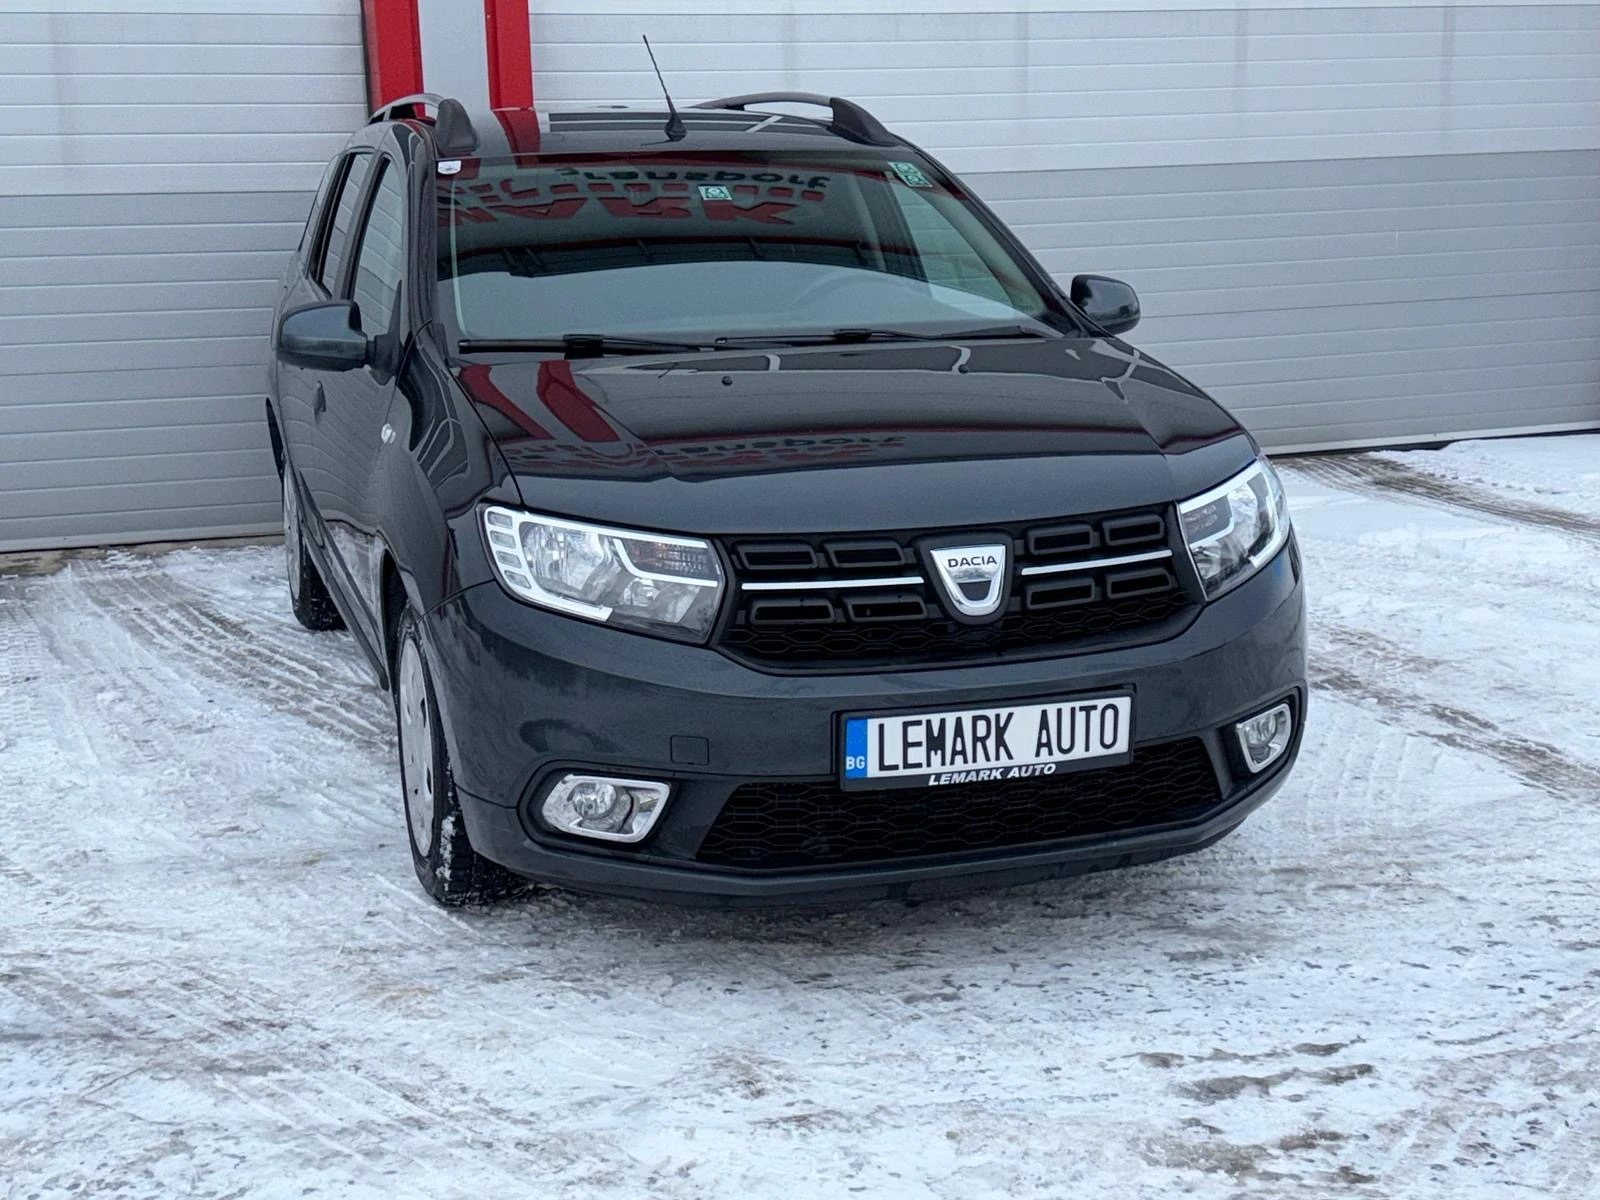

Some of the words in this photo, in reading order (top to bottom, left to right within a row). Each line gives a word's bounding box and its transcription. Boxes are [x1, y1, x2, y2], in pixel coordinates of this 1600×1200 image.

[947, 555, 998, 568] DACIA
[878, 711, 1015, 772] LEMARK
[1034, 703, 1120, 758] AUTO
[846, 755, 866, 770] BG
[928, 767, 1005, 786] LEMARK
[1007, 763, 1056, 779] AUTO
